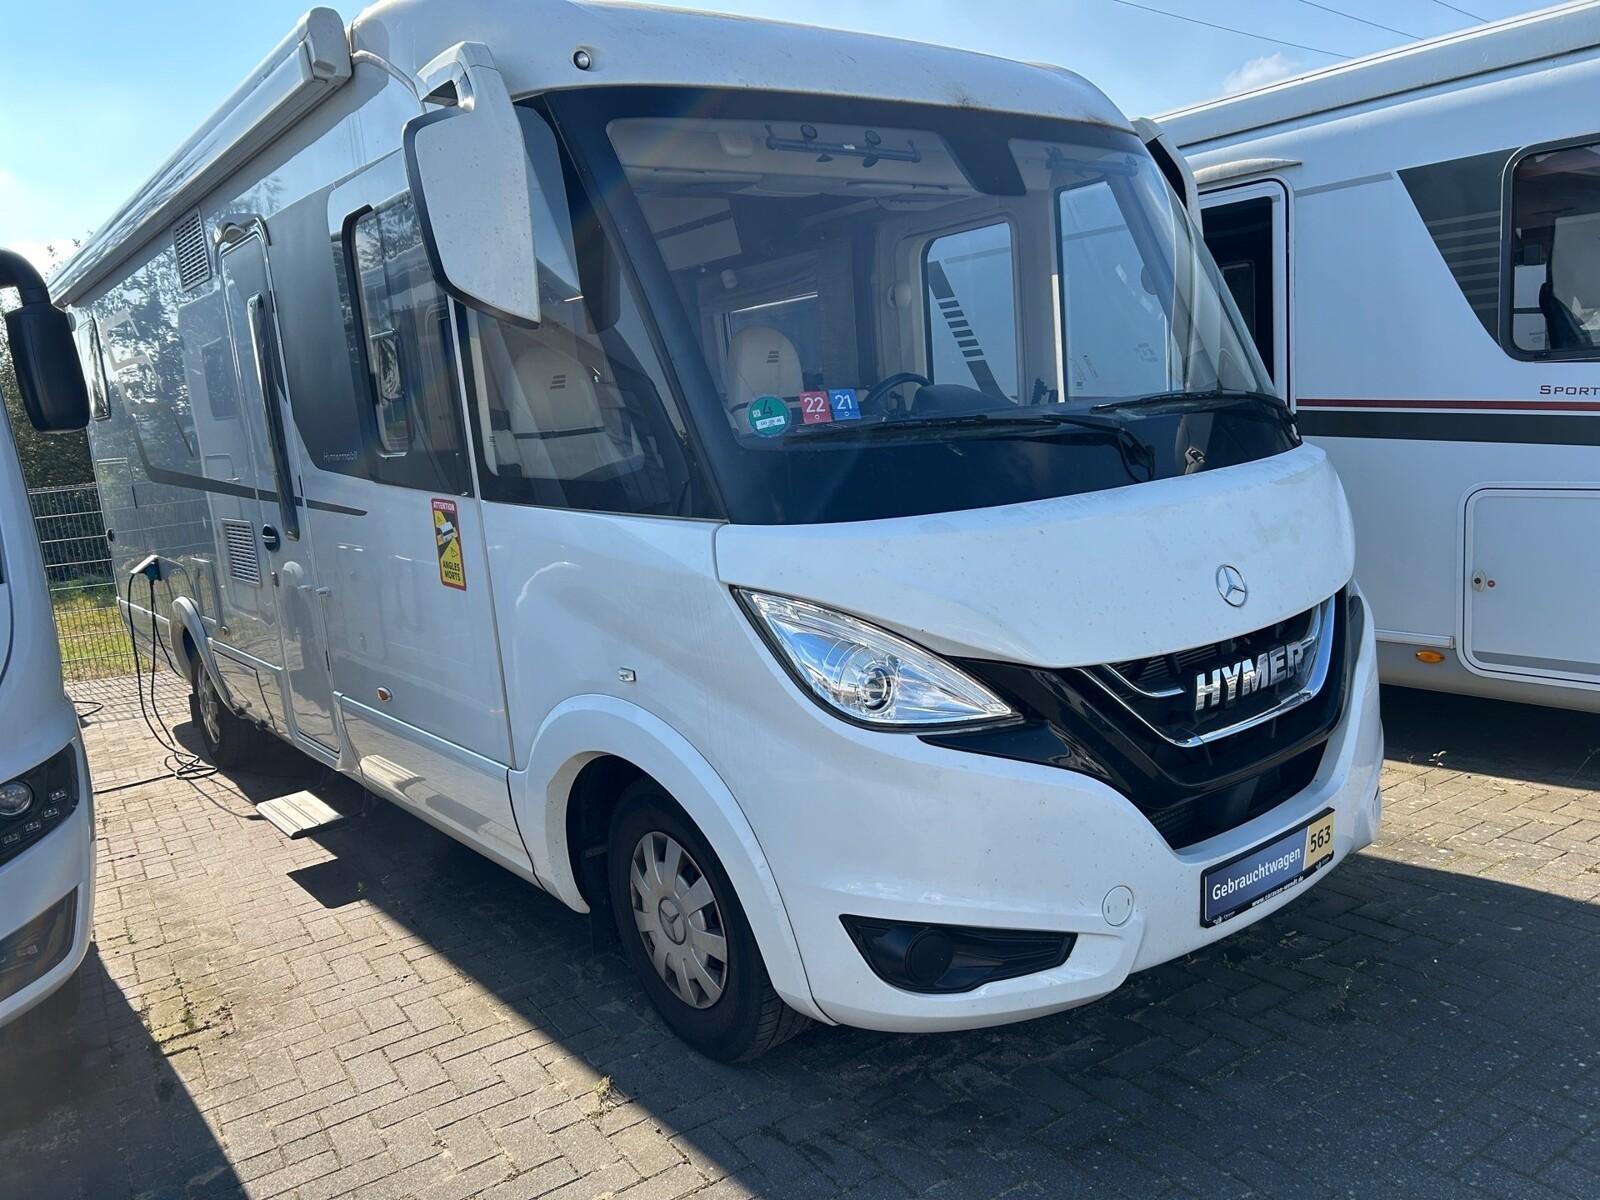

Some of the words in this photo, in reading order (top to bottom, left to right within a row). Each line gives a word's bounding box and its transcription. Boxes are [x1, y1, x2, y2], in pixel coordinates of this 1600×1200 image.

[762, 400, 773, 415] 4
[804, 397, 825, 413] 22
[834, 394, 853, 410] 21
[433, 501, 455, 511] ATTENTION
[442, 560, 461, 572] ANGLES
[444, 571, 461, 581] MORTS
[1195, 642, 1304, 710] HYMER
[1212, 848, 1301, 901] Gebrauchtwagen
[1310, 825, 1331, 853] 563
